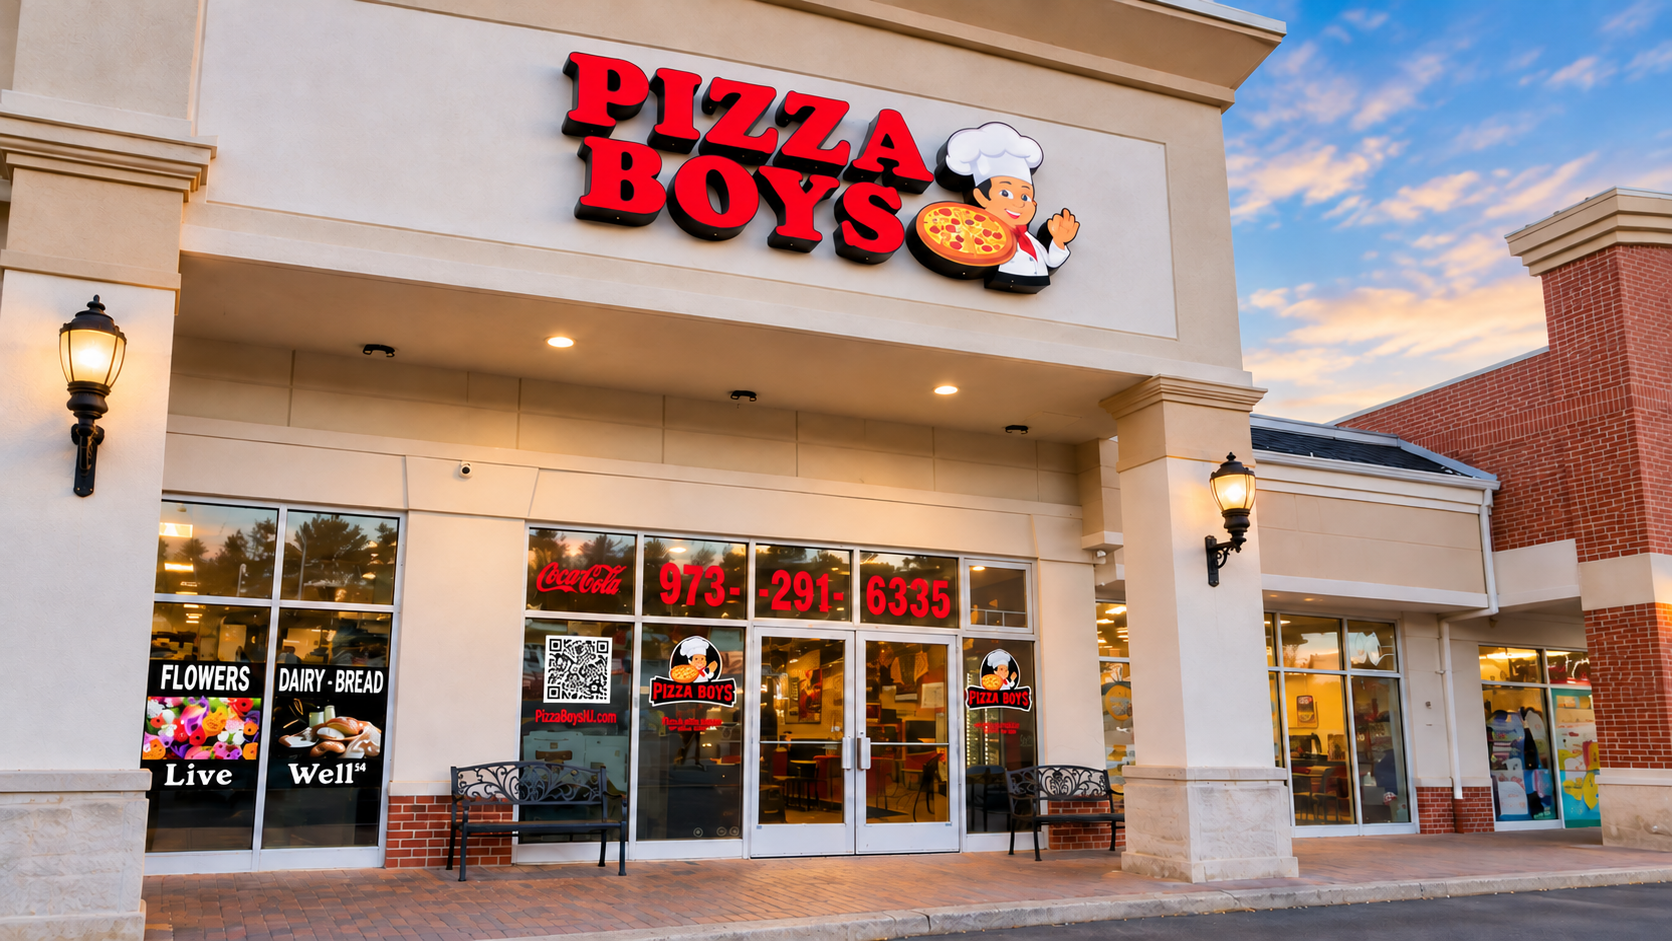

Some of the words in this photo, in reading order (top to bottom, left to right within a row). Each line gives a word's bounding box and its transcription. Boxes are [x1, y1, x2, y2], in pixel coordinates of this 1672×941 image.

[565, 51, 934, 188] PIZZA
[577, 136, 906, 259] BOYS
[536, 561, 627, 595] Coca-Cola
[659, 562, 740, 607] 973-
[758, 569, 844, 612] -291-
[866, 575, 951, 619] 6335
[160, 664, 251, 692] FLOWERS
[278, 667, 326, 692] DAIRY
[334, 669, 384, 694] BREAD
[653, 682, 693, 700] PIZZA
[697, 684, 733, 702] BOYS
[968, 690, 999, 705] PIZZA
[1002, 690, 1029, 707] BOYS
[164, 762, 233, 786] Live
